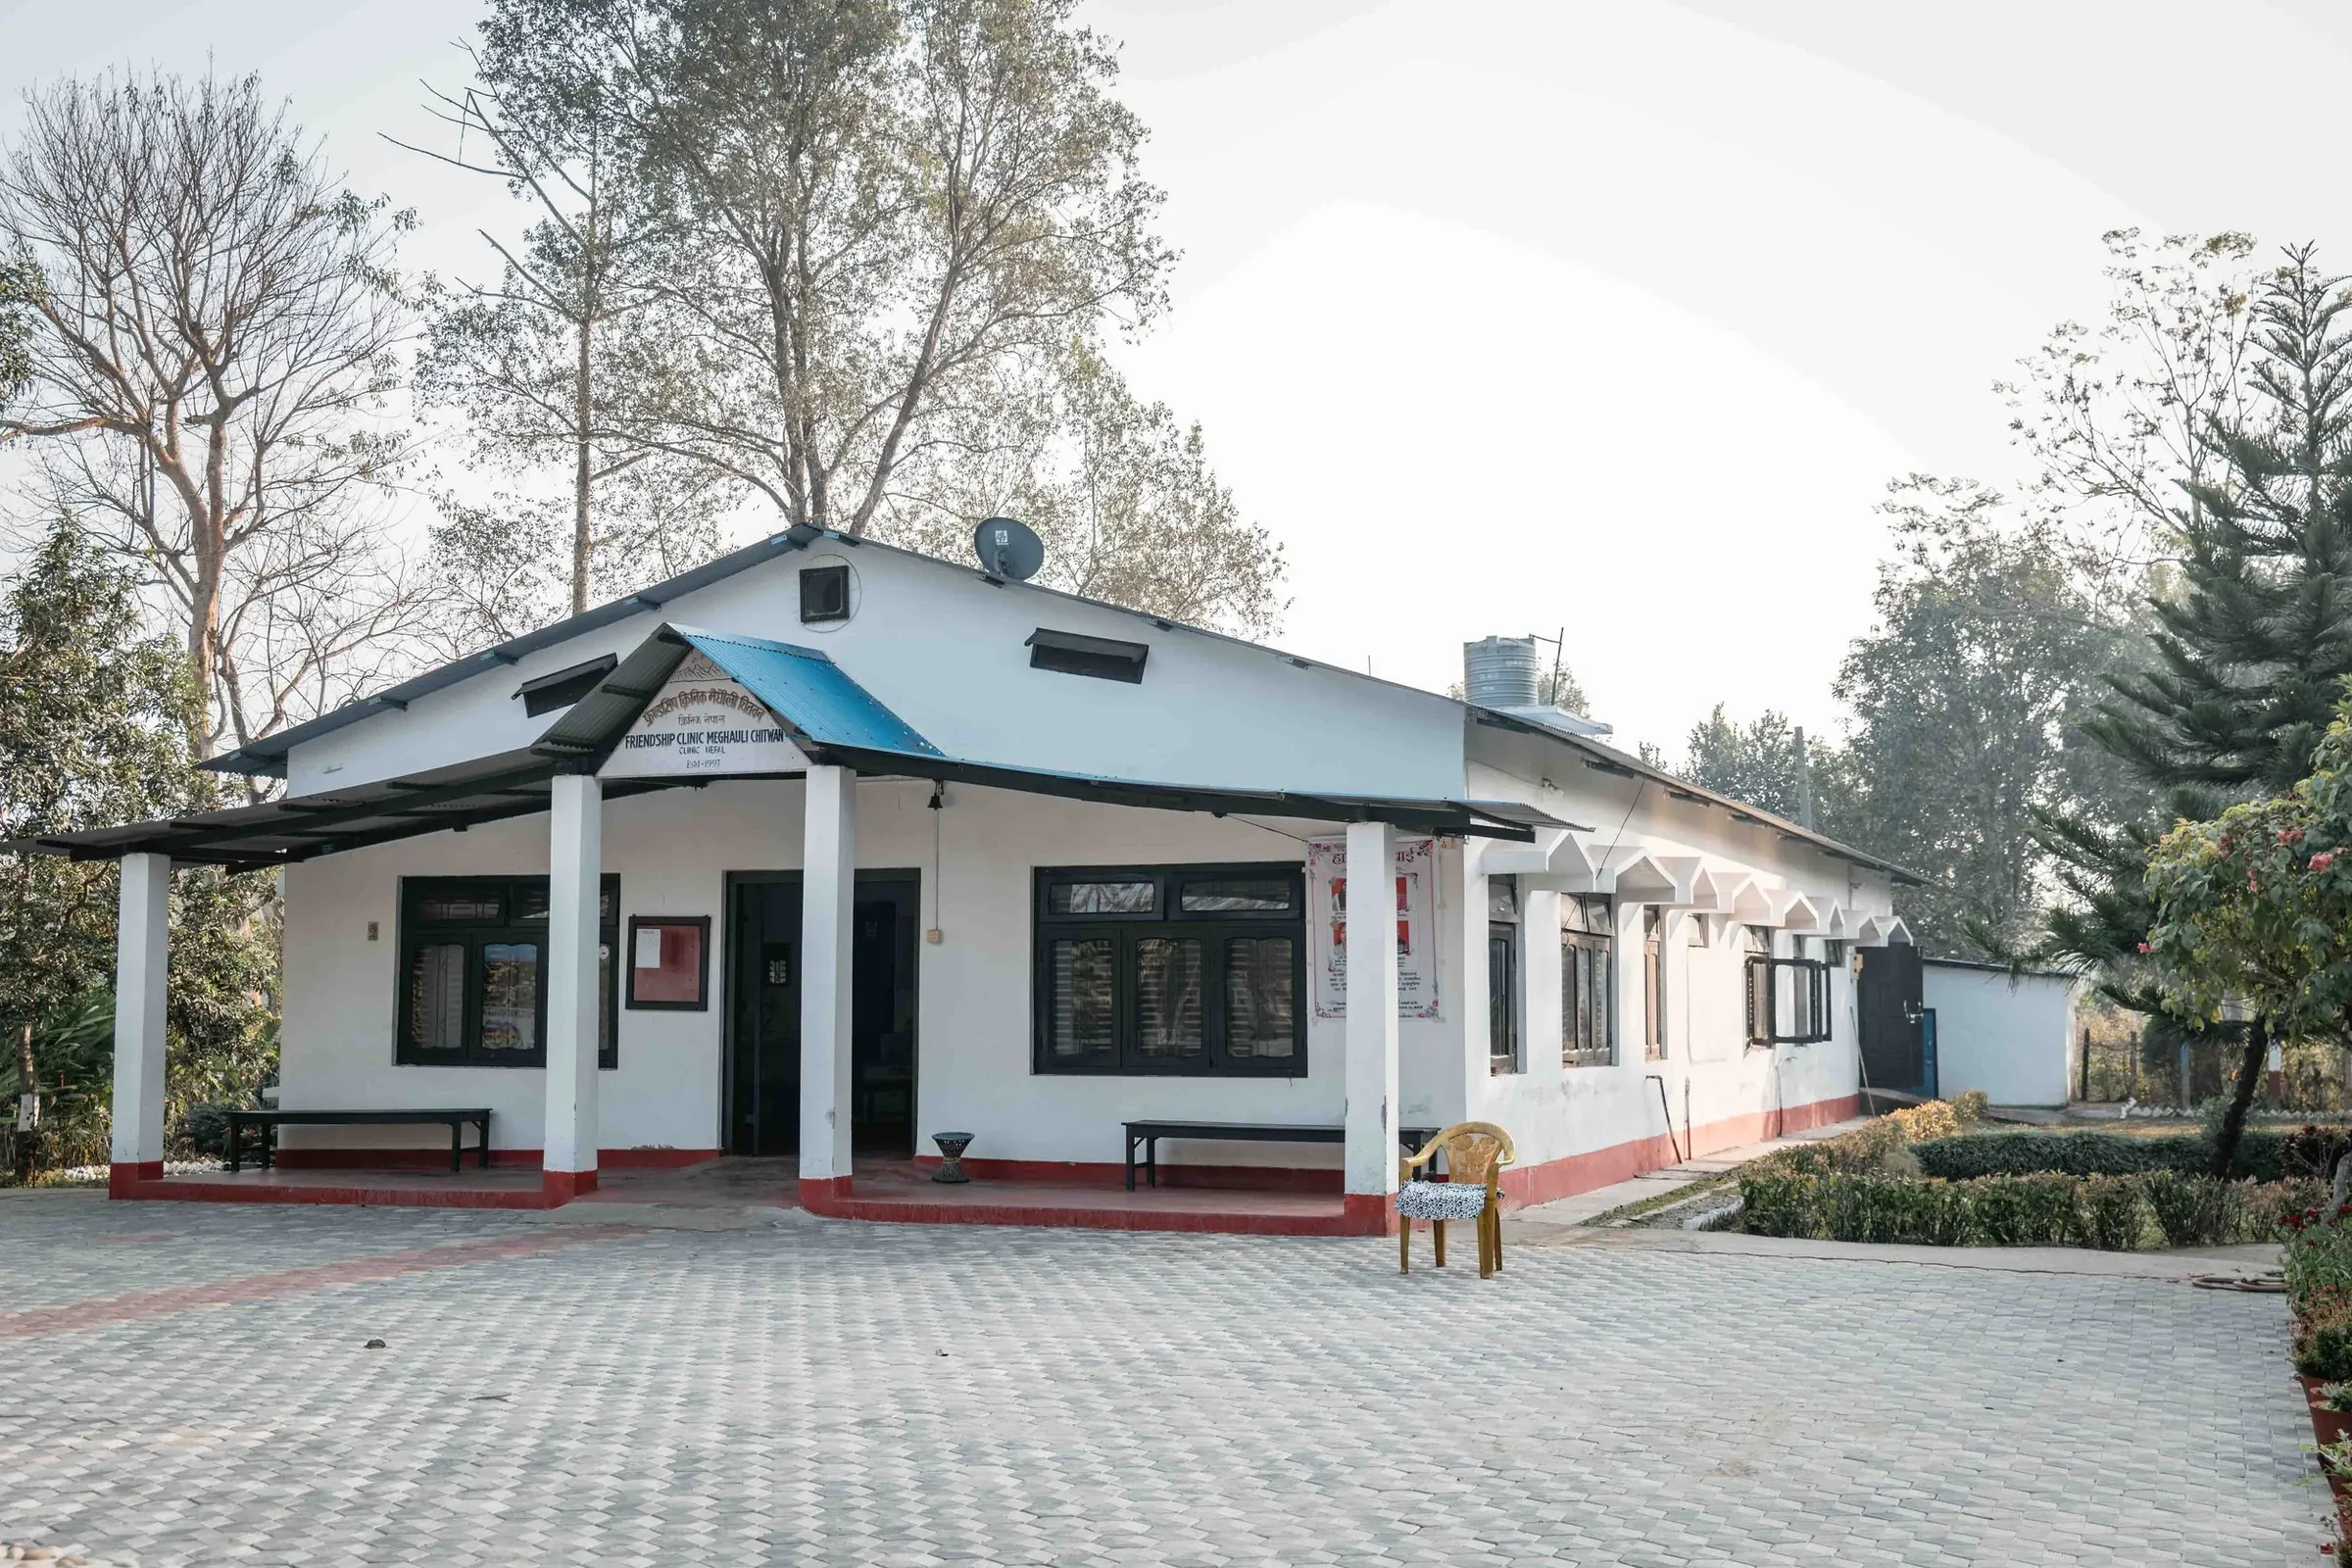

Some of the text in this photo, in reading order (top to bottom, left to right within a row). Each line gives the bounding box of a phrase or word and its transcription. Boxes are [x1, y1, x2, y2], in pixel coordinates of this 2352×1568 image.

[625, 729, 784, 749] FRIENDSHIP CLINIC MEGHAULI CHITWAN
